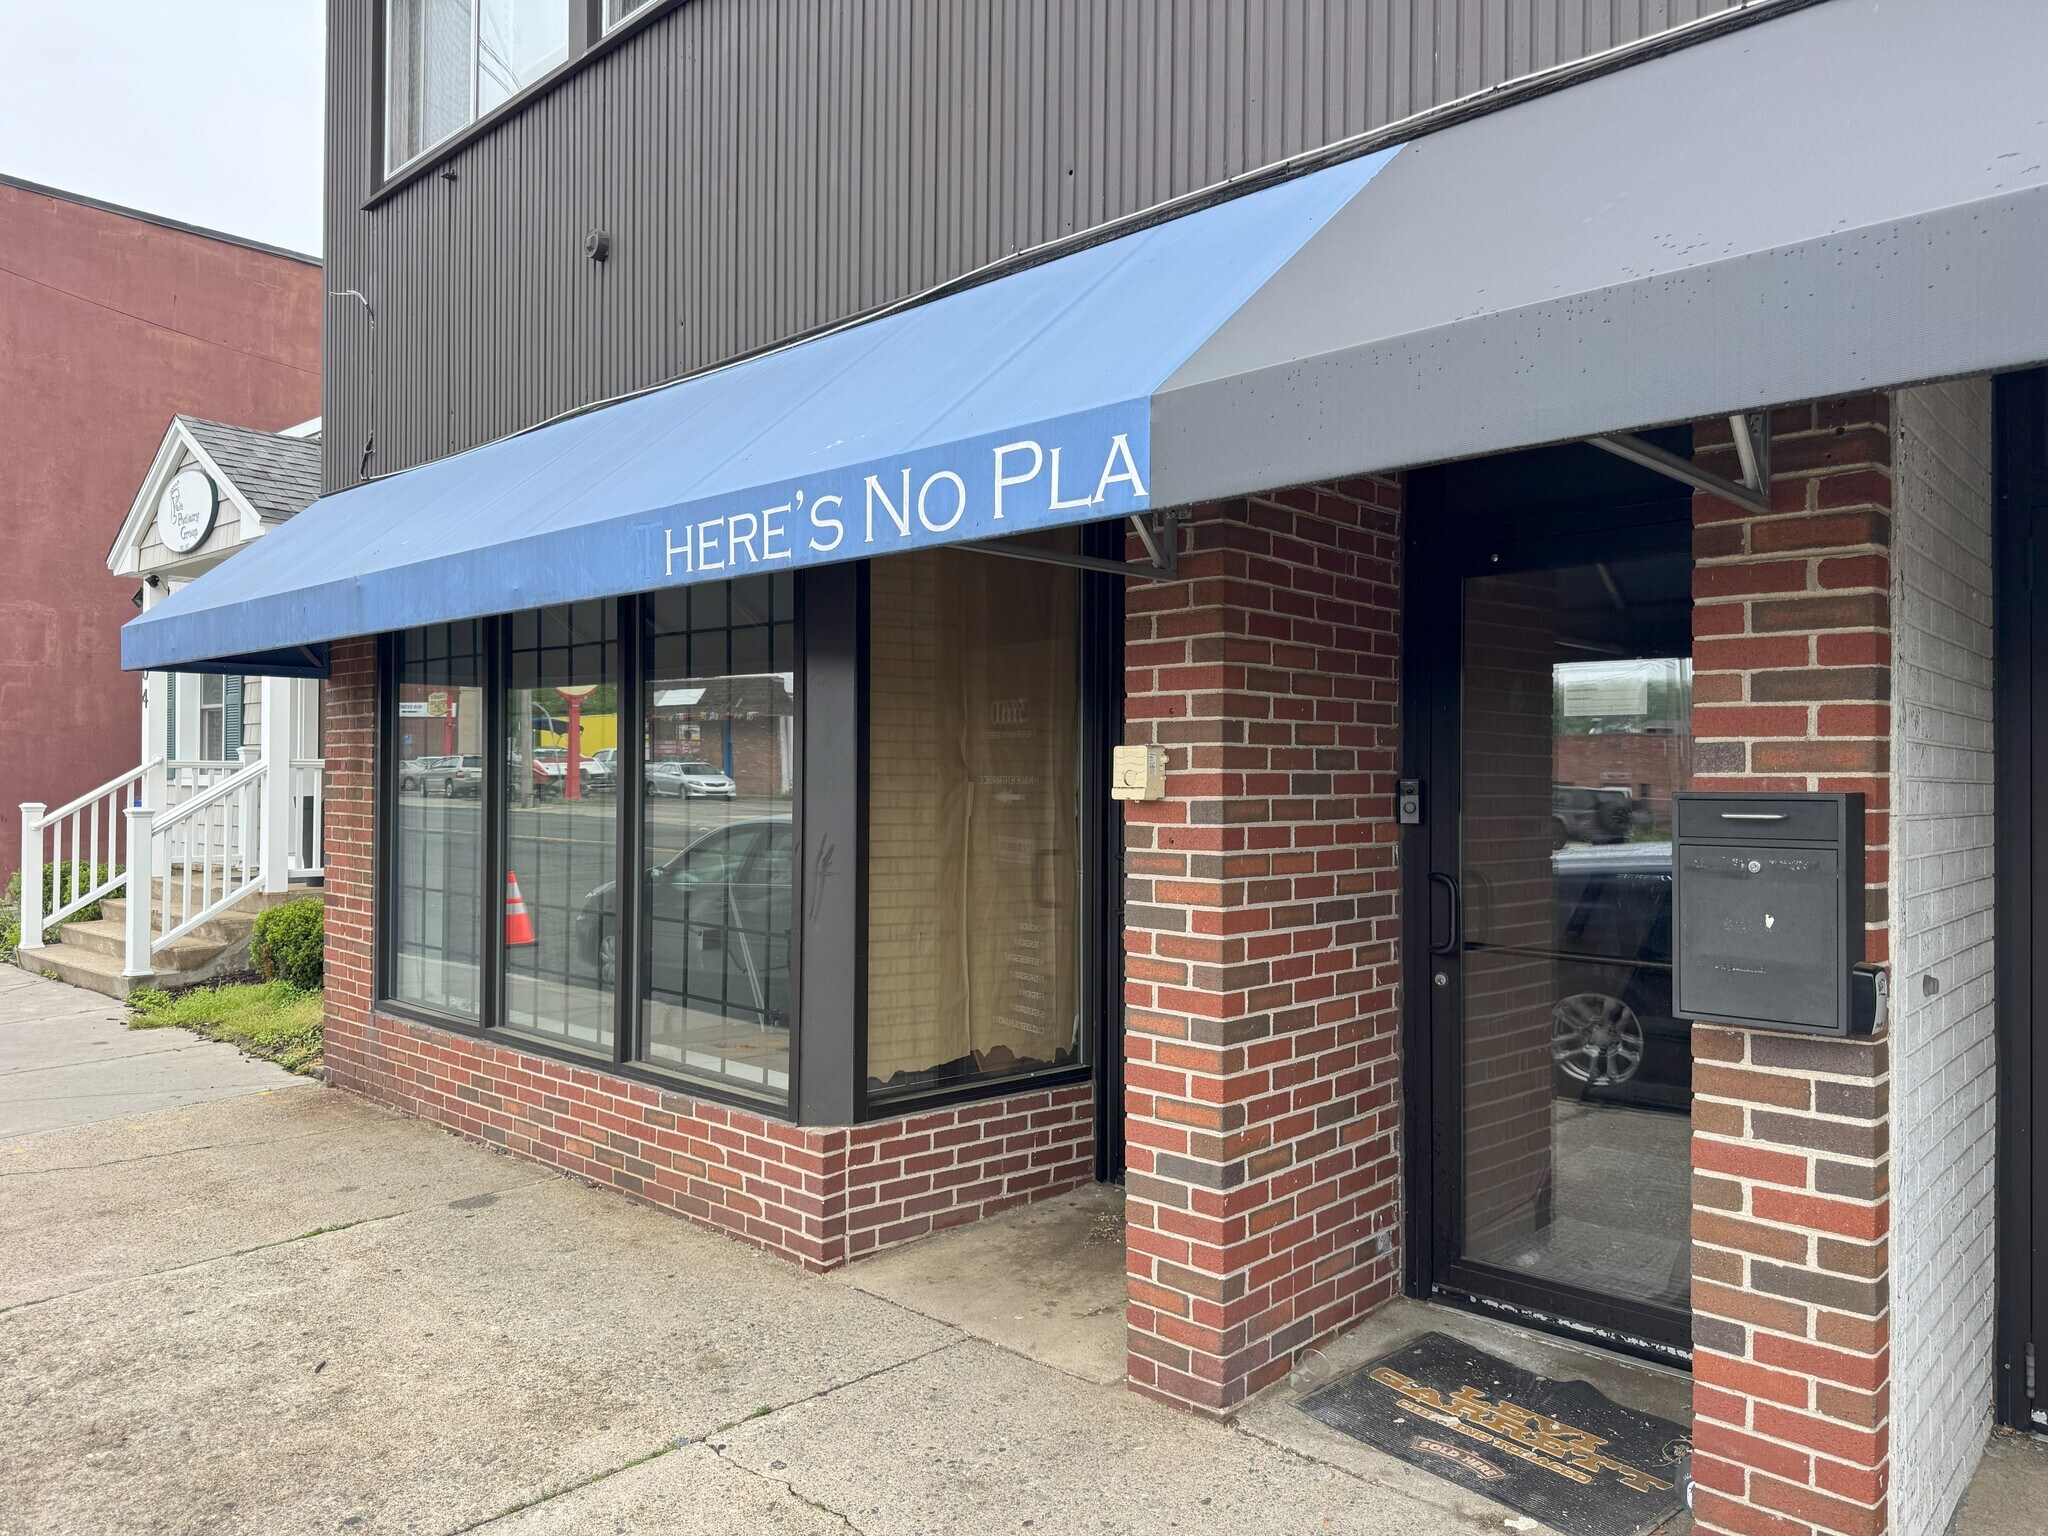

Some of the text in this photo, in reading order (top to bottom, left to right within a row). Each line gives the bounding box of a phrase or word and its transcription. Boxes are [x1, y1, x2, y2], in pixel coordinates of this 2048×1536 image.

[864, 468, 967, 543] NO
[993, 433, 1149, 520] PLA
[180, 526, 198, 540] Group
[1370, 1367, 1675, 1493] GARRETT
[1449, 1385, 1608, 1453] LEVI
[1419, 1440, 1498, 1477] SOLD HERE
